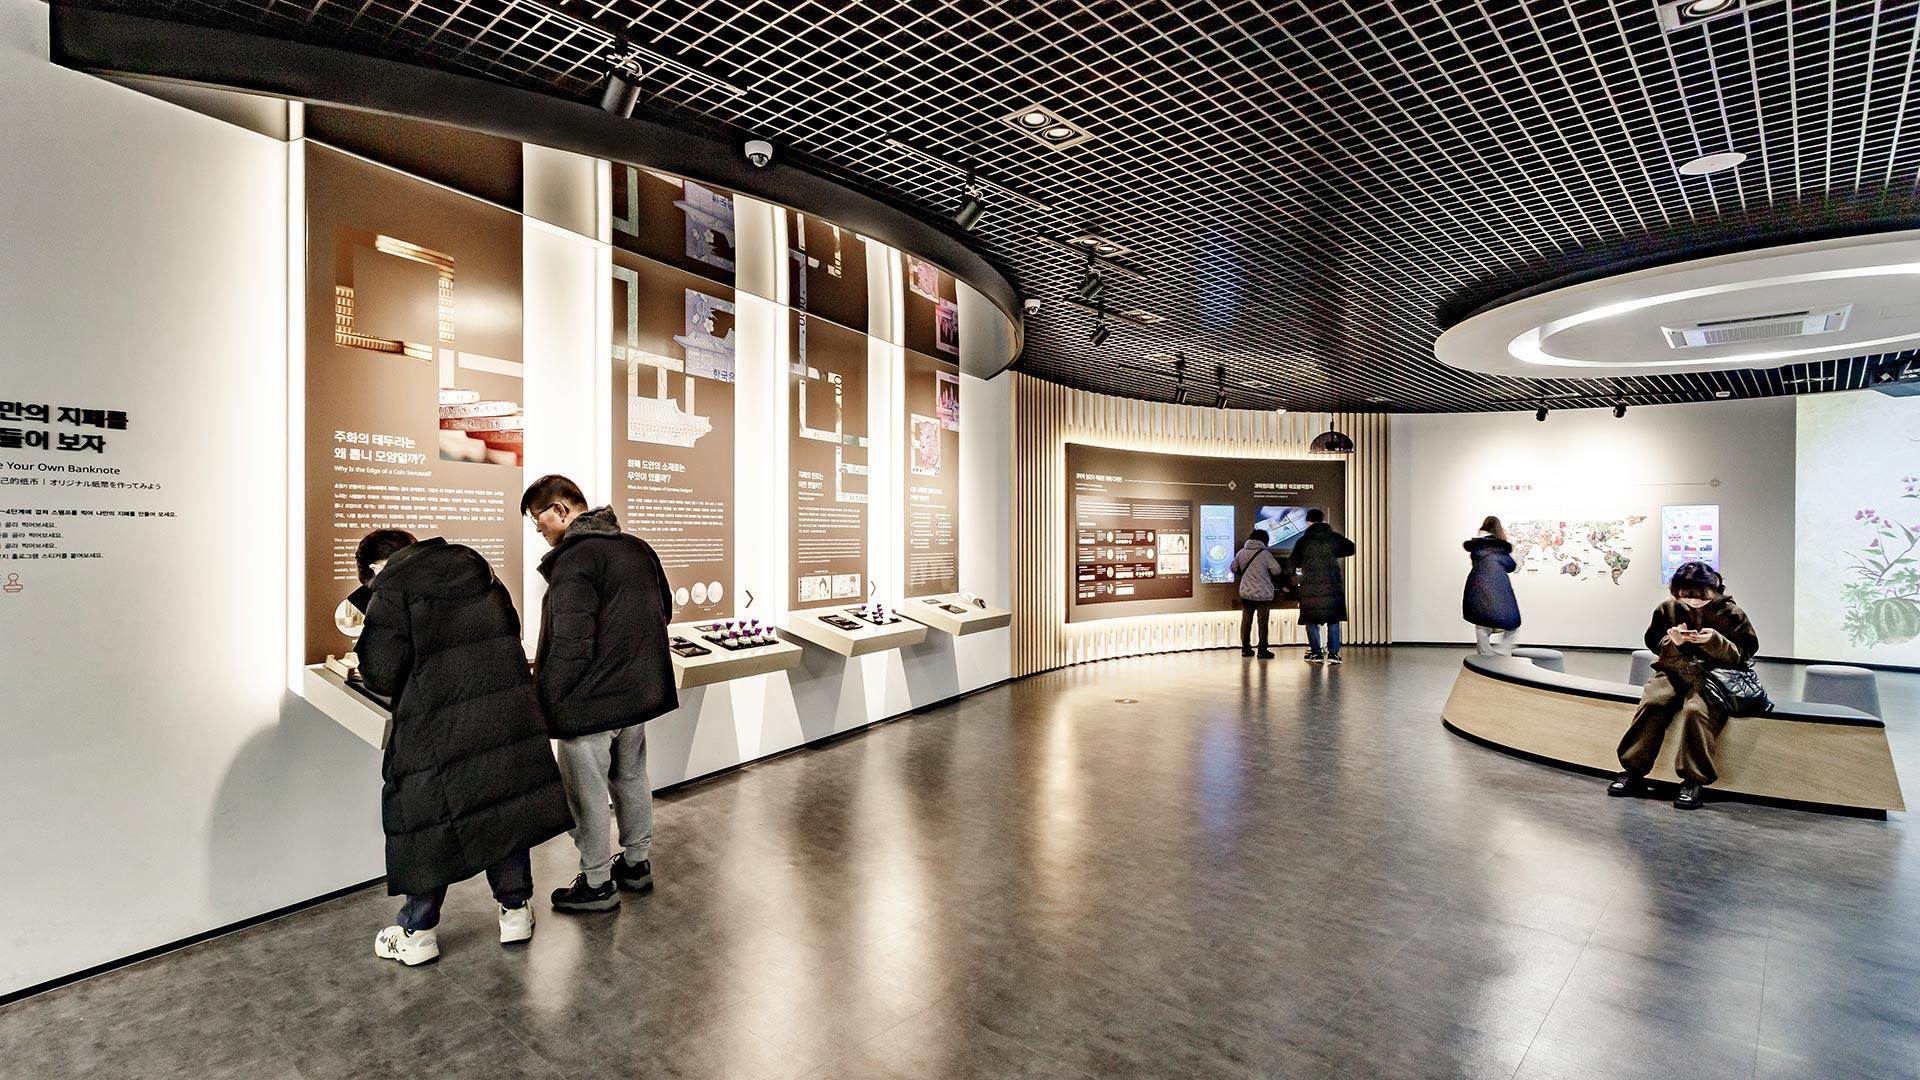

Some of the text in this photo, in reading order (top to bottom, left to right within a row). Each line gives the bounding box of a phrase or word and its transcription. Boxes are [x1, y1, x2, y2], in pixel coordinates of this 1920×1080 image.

[0, 401, 128, 430] 만의 지폐를
[0, 427, 106, 453] 들어 보자
[334, 430, 416, 448] 주화의 테두리는
[334, 447, 346, 460] 왜
[375, 450, 426, 465] 모양일까?
[7, 462, 35, 471] Your
[37, 463, 65, 472] Own
[68, 465, 121, 475] Banknote
[334, 465, 348, 473] Why
[367, 467, 380, 475] Edge
[50, 479, 162, 490] オリジナル紙幣を作ってみよう
